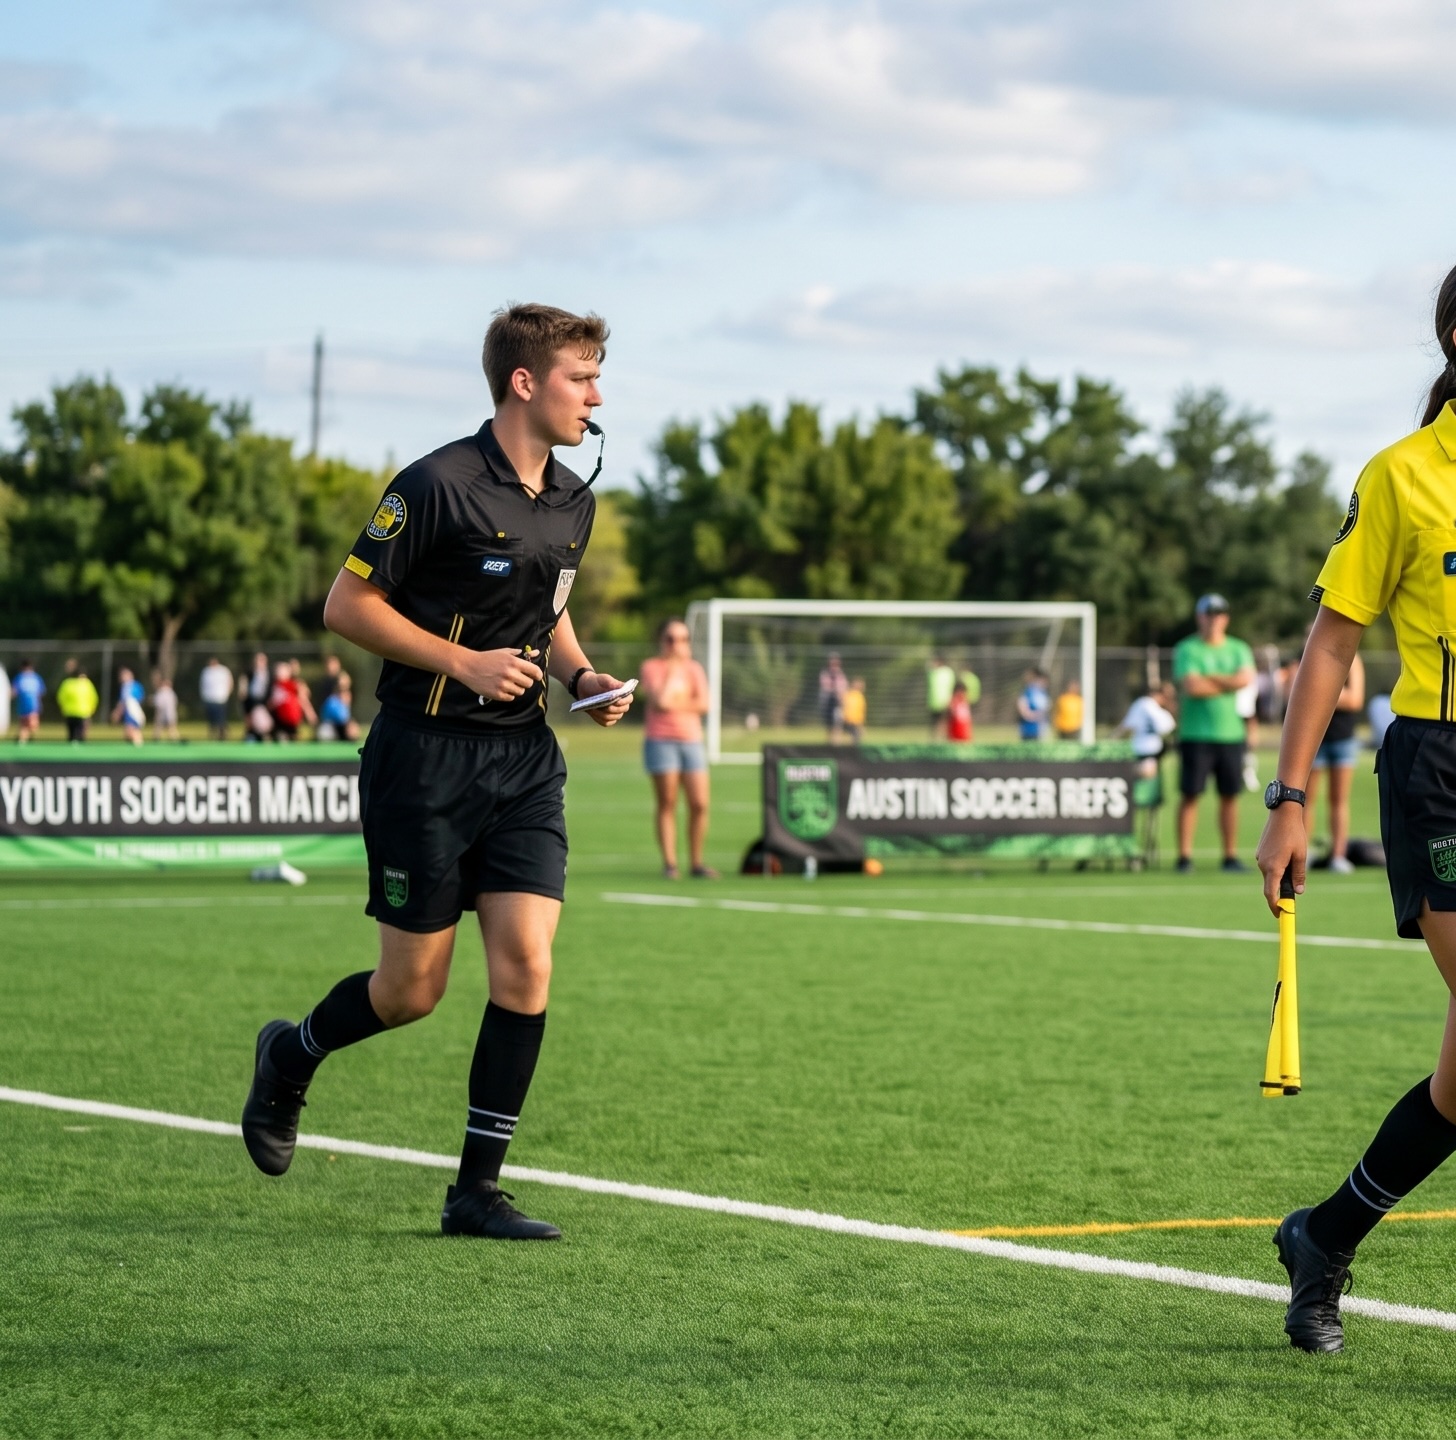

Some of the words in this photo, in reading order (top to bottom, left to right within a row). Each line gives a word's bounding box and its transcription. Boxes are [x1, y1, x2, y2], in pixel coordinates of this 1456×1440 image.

[0, 775, 113, 825] YOUTH
[120, 775, 252, 825] SOCCER
[846, 777, 949, 821] AUSTIN
[950, 776, 1057, 821] SOCCER
[1058, 776, 1129, 820] REFS
